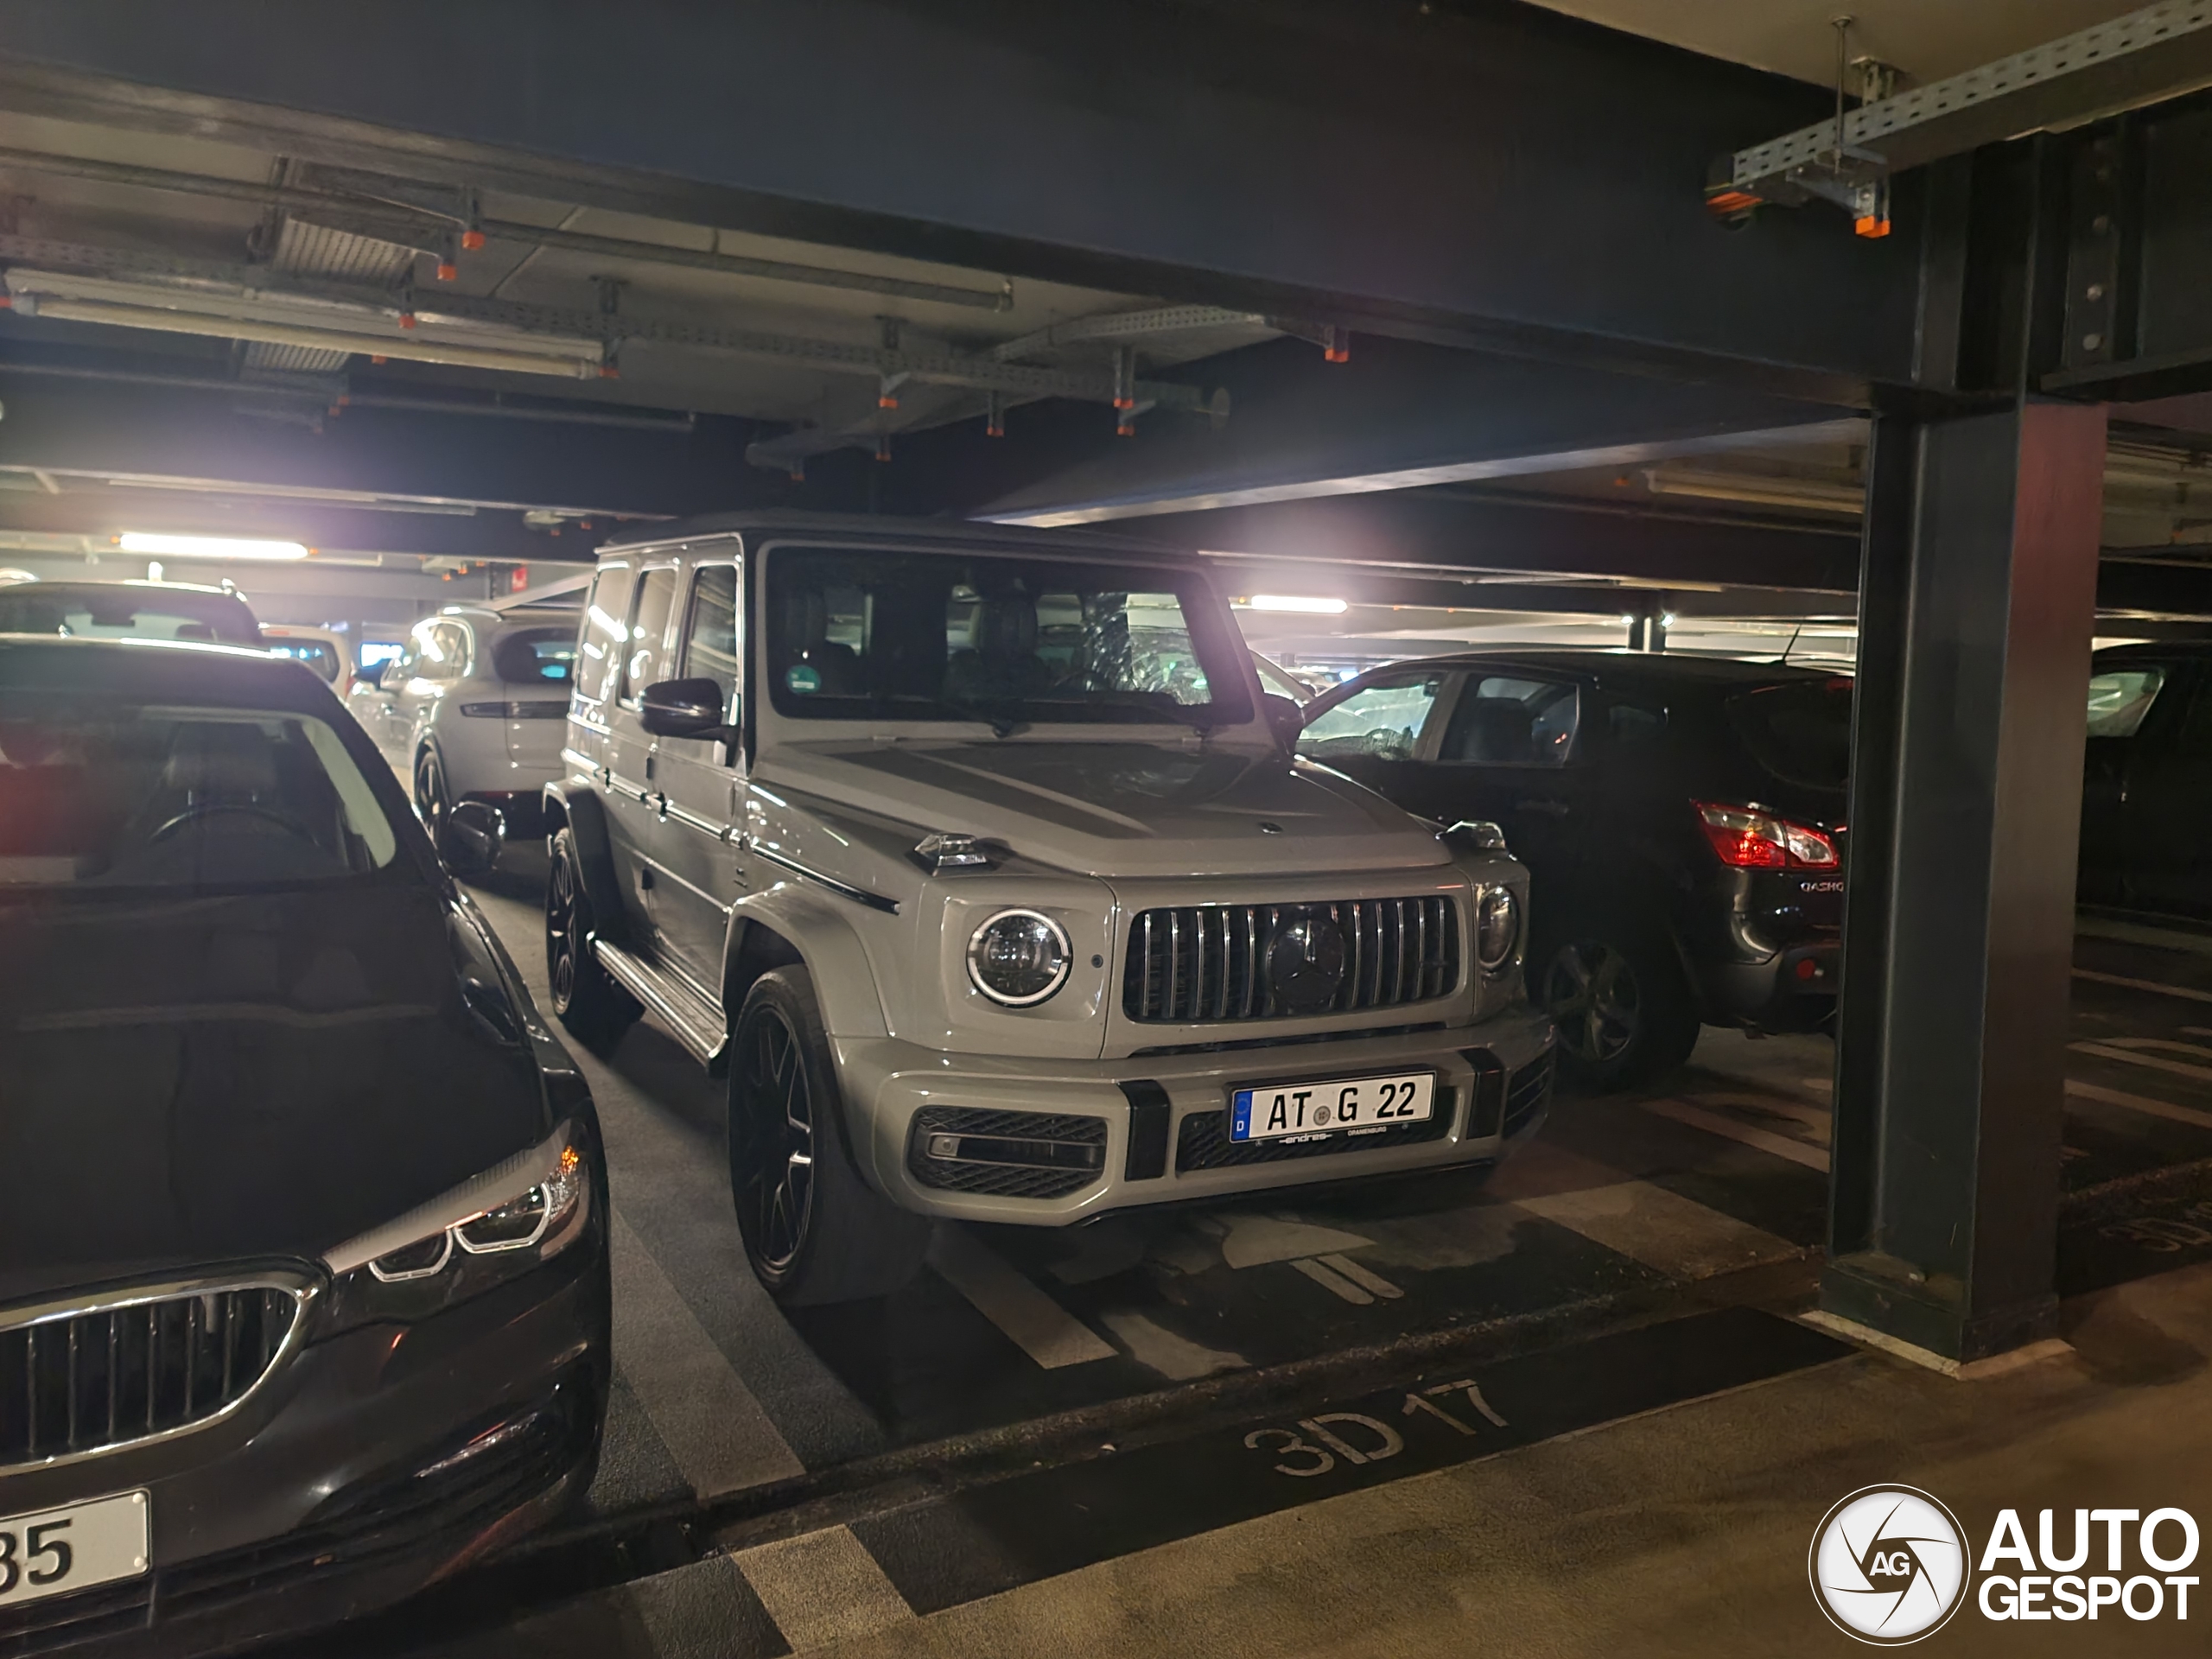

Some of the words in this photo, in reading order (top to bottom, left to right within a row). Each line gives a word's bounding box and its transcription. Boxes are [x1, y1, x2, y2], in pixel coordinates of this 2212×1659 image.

[1236, 1120, 1245, 1132] D
[1267, 1090, 1313, 1131] AT
[1338, 1087, 1358, 1122] G
[1376, 1082, 1416, 1119] 22
[1244, 1412, 1404, 1477] 3D
[1402, 1379, 1509, 1435] 17
